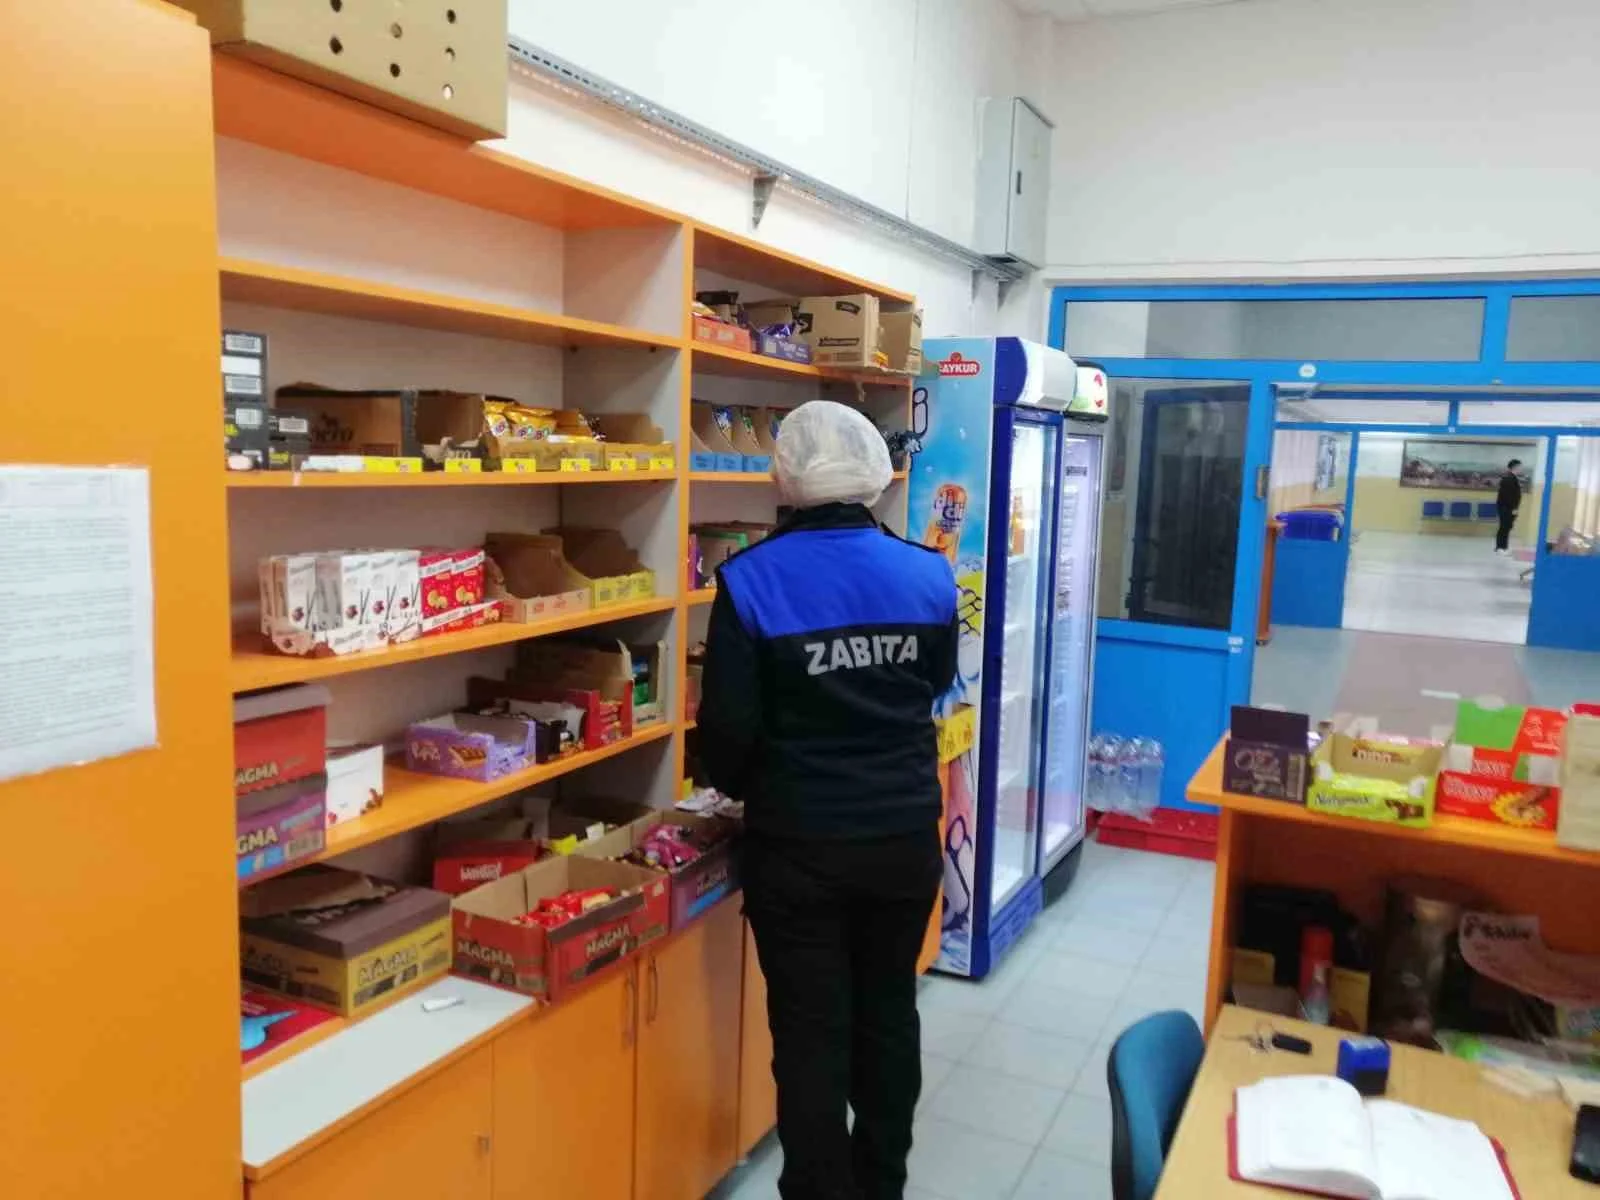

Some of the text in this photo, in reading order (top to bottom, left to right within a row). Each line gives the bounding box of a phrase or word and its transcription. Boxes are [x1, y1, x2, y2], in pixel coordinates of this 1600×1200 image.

[804, 635, 918, 676] ZABITA
[456, 941, 515, 968] MAGMA
[586, 924, 631, 957] MAGMA
